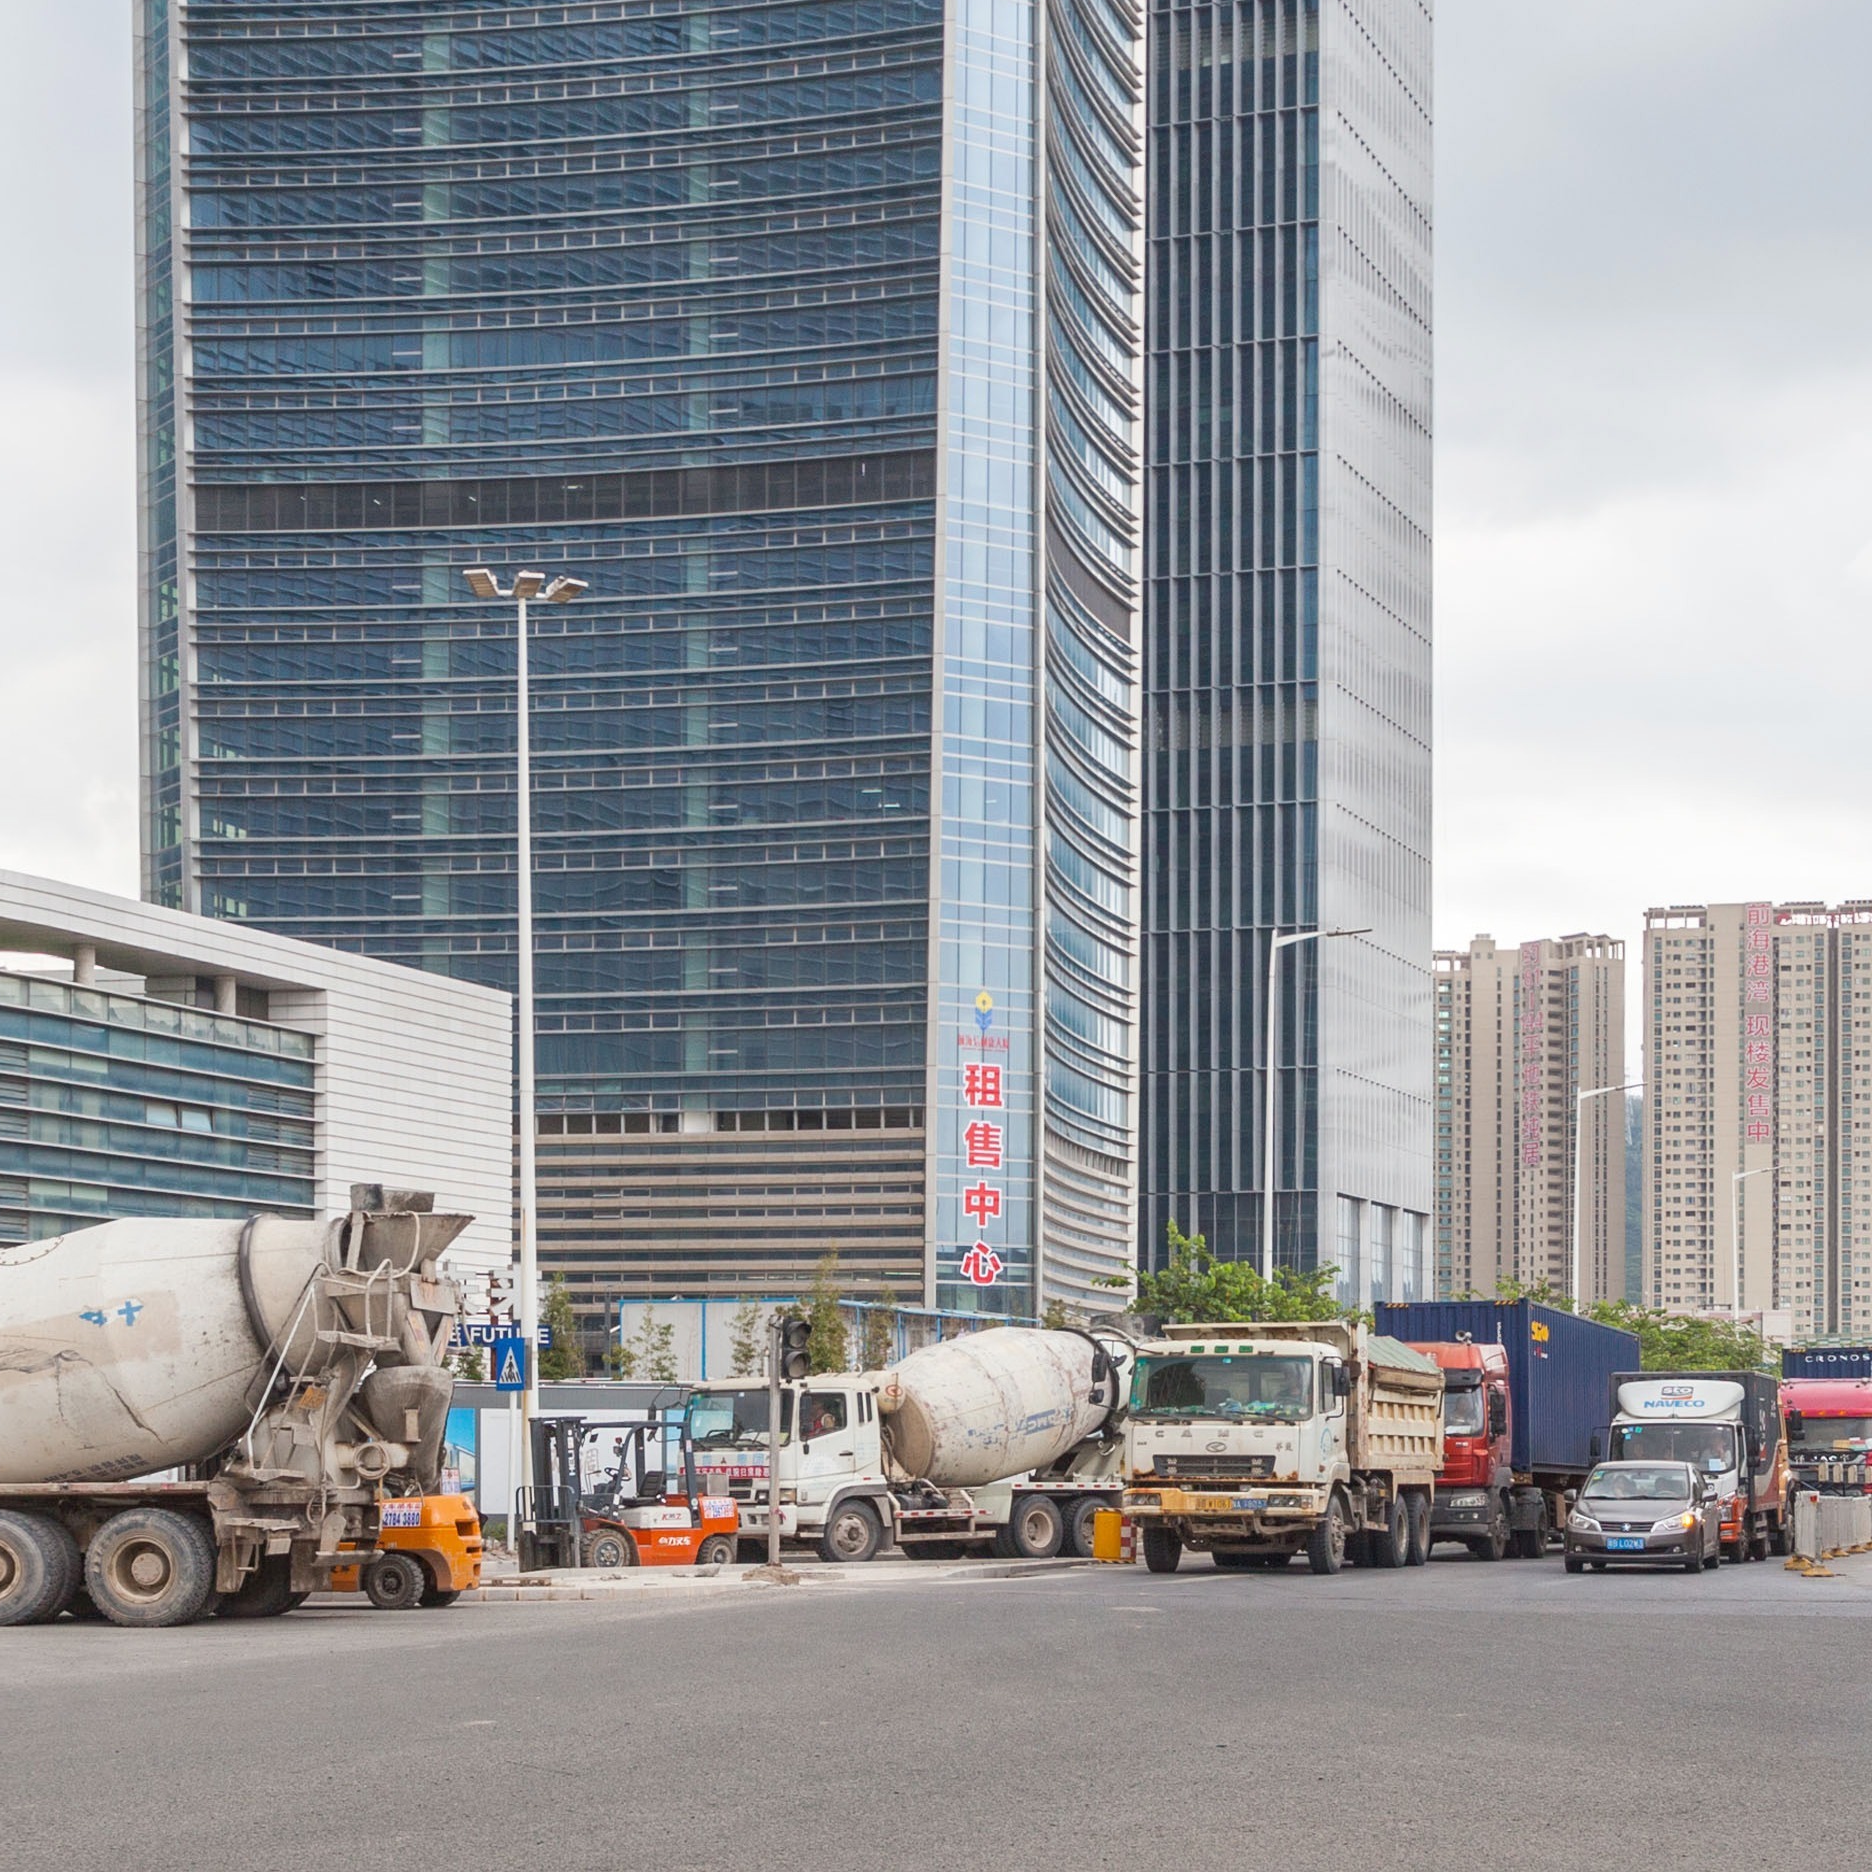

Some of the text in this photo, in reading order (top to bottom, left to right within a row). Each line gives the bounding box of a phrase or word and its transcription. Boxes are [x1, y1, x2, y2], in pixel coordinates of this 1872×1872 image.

[1745, 904, 1770, 1142] 前海港湾 现楼发售中
[960, 1062, 1003, 1287] 租售中心
[470, 1327, 549, 1344] FUTUE
[1805, 1354, 1870, 1363] CRONOS
[1644, 1400, 1705, 1408] NAVECO
